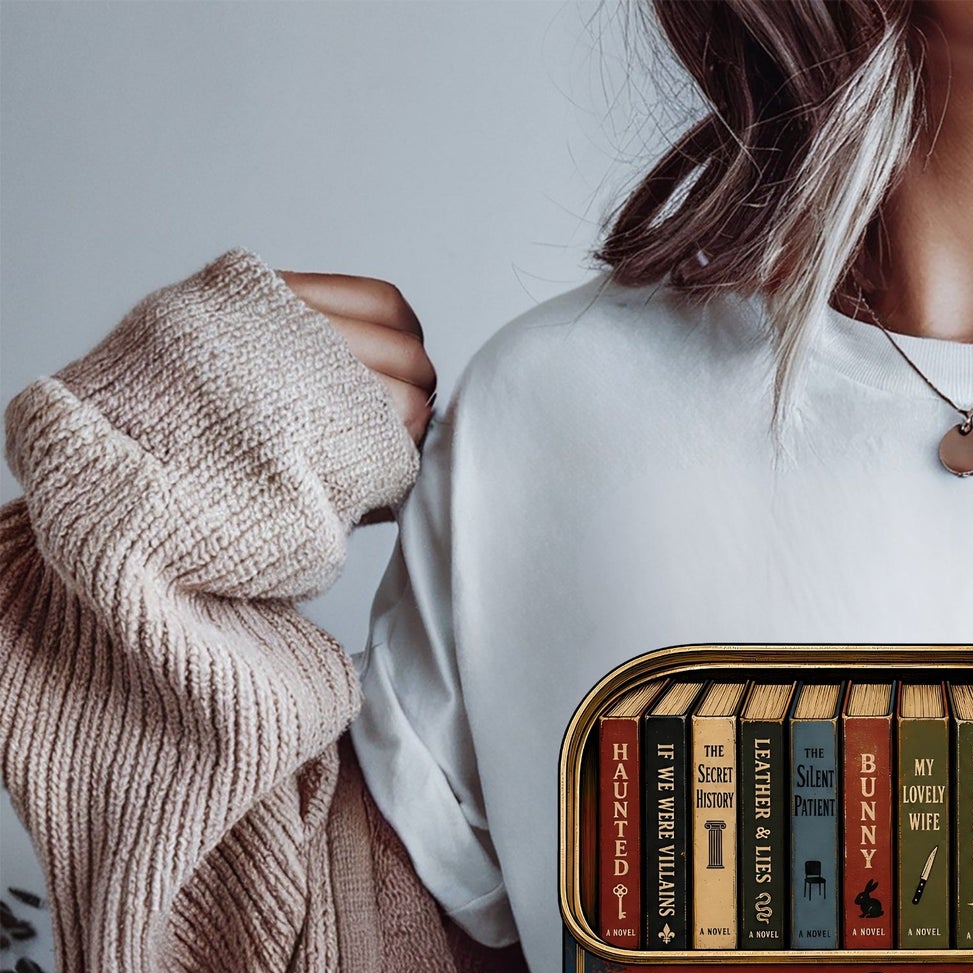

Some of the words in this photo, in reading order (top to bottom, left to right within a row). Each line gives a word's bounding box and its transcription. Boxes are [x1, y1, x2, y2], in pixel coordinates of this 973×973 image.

[657, 743, 674, 758] IF
[704, 745, 725, 758] THE
[804, 748, 824, 759] THE
[914, 758, 934, 776] MY
[657, 762, 674, 791] WE
[754, 738, 771, 820] LEATHER
[903, 786, 945, 804] LOVELY
[613, 743, 629, 877] HAUNTED
[657, 795, 675, 840] WERE
[860, 754, 877, 870] BUNNY
[909, 812, 940, 831] WIFE
[755, 827, 771, 839] &
[755, 845, 771, 884] LIES
[657, 844, 676, 917] VILLAINS
[606, 927, 611, 937] A
[613, 927, 636, 937] NOVEL
[699, 927, 705, 936] A
[707, 927, 731, 936] NOVEL
[749, 929, 754, 939] A
[756, 929, 779, 939] NOVEL
[798, 928, 804, 938] A
[806, 928, 831, 938] NOVEL
[852, 927, 858, 936] A
[860, 927, 886, 936] NOVEL
[908, 927, 913, 936] A
[916, 927, 941, 936] NOVEL
[966, 930, 972, 940] A
